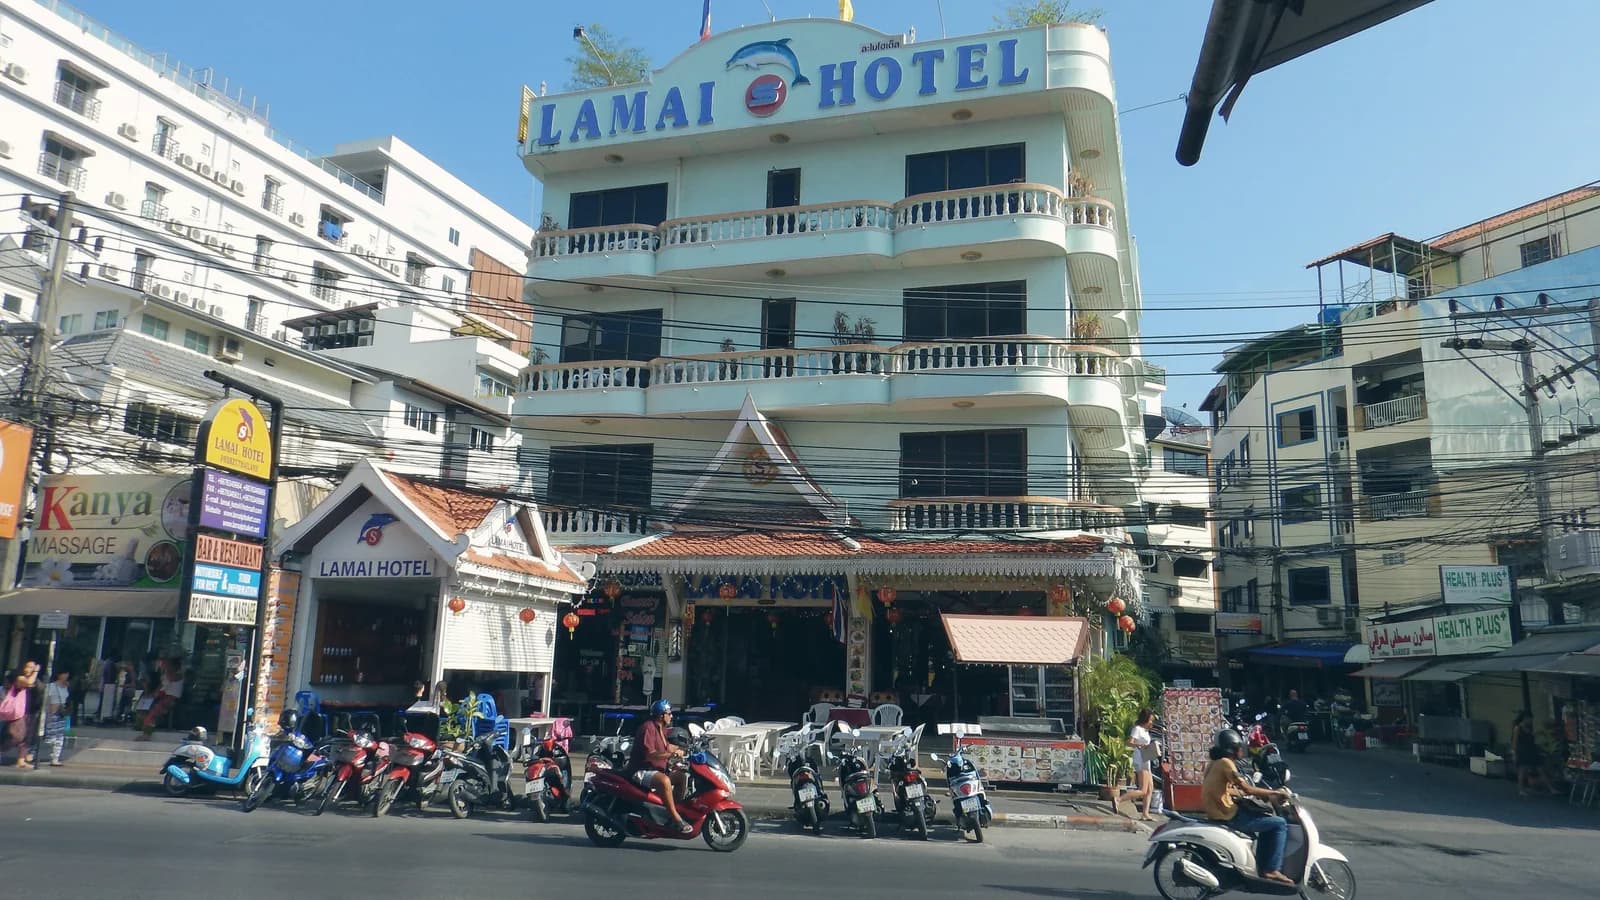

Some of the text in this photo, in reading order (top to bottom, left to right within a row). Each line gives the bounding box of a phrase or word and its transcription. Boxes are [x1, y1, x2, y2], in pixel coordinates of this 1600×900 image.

[538, 39, 1030, 147] LAMAI HOTEL
[215, 437, 265, 464] LAMAI HOTEL
[35, 486, 153, 531] Kanya
[32, 536, 117, 555] MASSAGE
[197, 538, 213, 561] BAR
[219, 540, 262, 569] RESTAURANT
[320, 560, 432, 577] LAMAI HOTEL
[1445, 570, 1477, 588] HEALTH
[231, 601, 257, 623] MASSAGE
[1437, 617, 1472, 640] HEALTH
